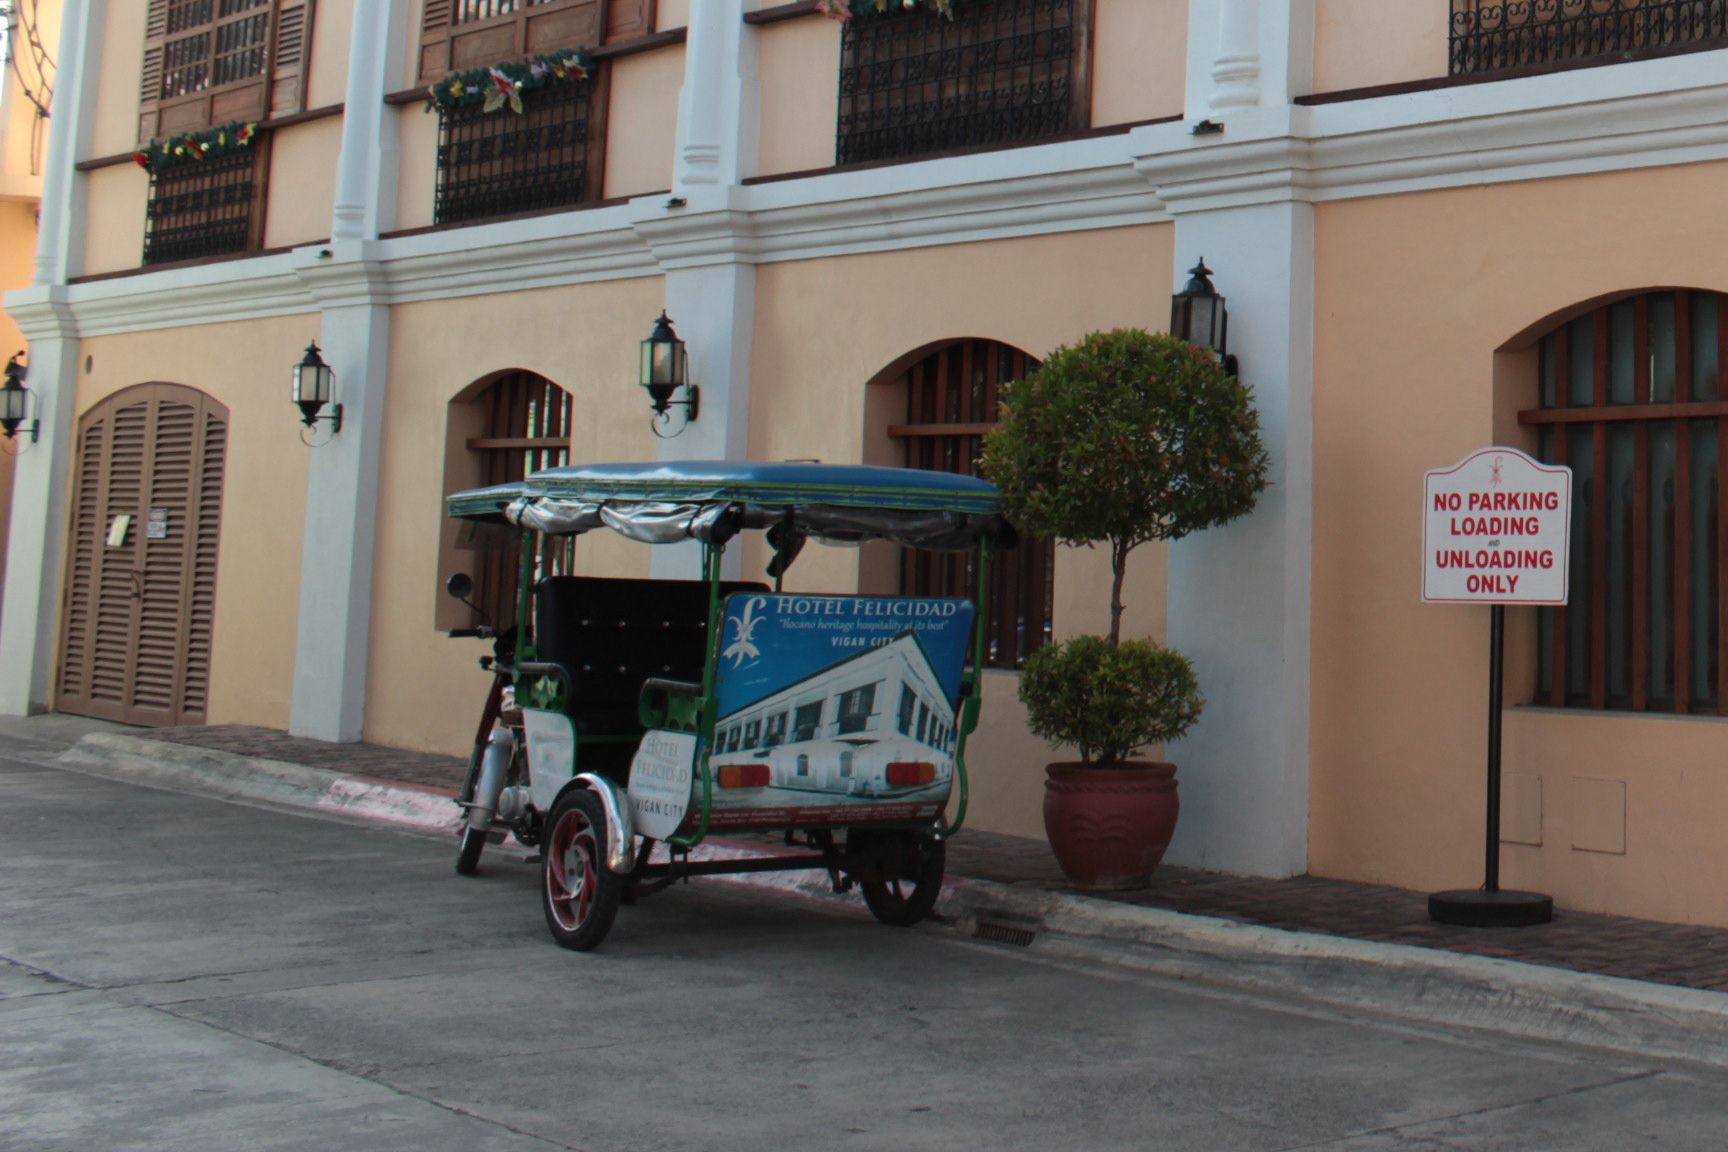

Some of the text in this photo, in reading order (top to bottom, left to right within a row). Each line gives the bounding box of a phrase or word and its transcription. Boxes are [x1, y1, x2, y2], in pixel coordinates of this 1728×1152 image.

[1434, 492, 1559, 511] NO PARKING
[1451, 517, 1539, 536] LOADING
[1436, 550, 1553, 569] UNLOADING
[1466, 575, 1520, 593] ONLY
[776, 598, 957, 616] HOTEL FELICIDAD
[817, 617, 853, 633] heritage
[831, 636, 866, 647] VIGAN
[646, 737, 680, 758] HOTEL
[635, 798, 661, 814] VIGAN
[663, 802, 685, 818] CITY
